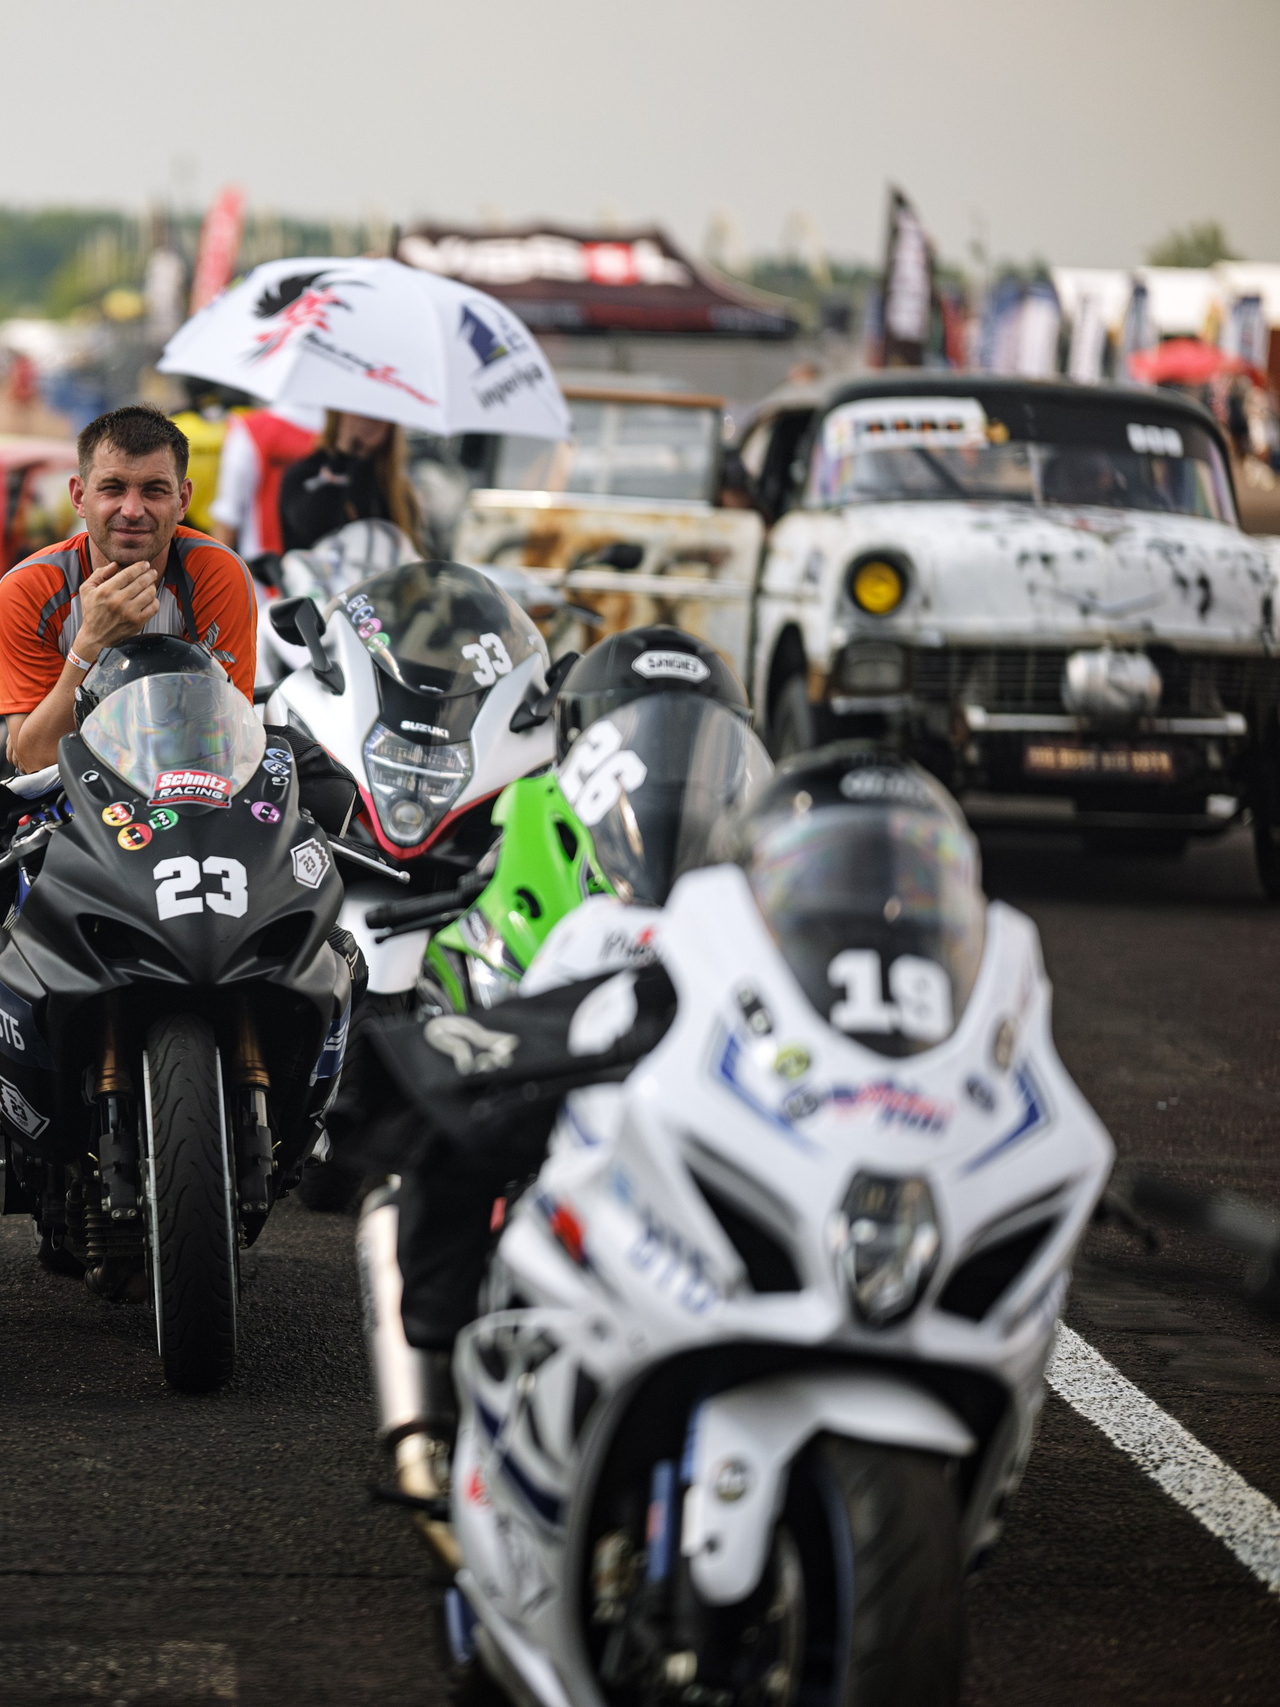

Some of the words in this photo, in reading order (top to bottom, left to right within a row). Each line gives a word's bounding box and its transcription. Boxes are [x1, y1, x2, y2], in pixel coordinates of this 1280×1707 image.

[461, 632, 513, 686] 33
[400, 720, 450, 739] SUZUKI
[158, 772, 228, 792] Schnitz
[158, 786, 224, 800] RACING
[558, 719, 648, 827] 26
[152, 855, 249, 921] 23
[825, 946, 954, 1043] 19
